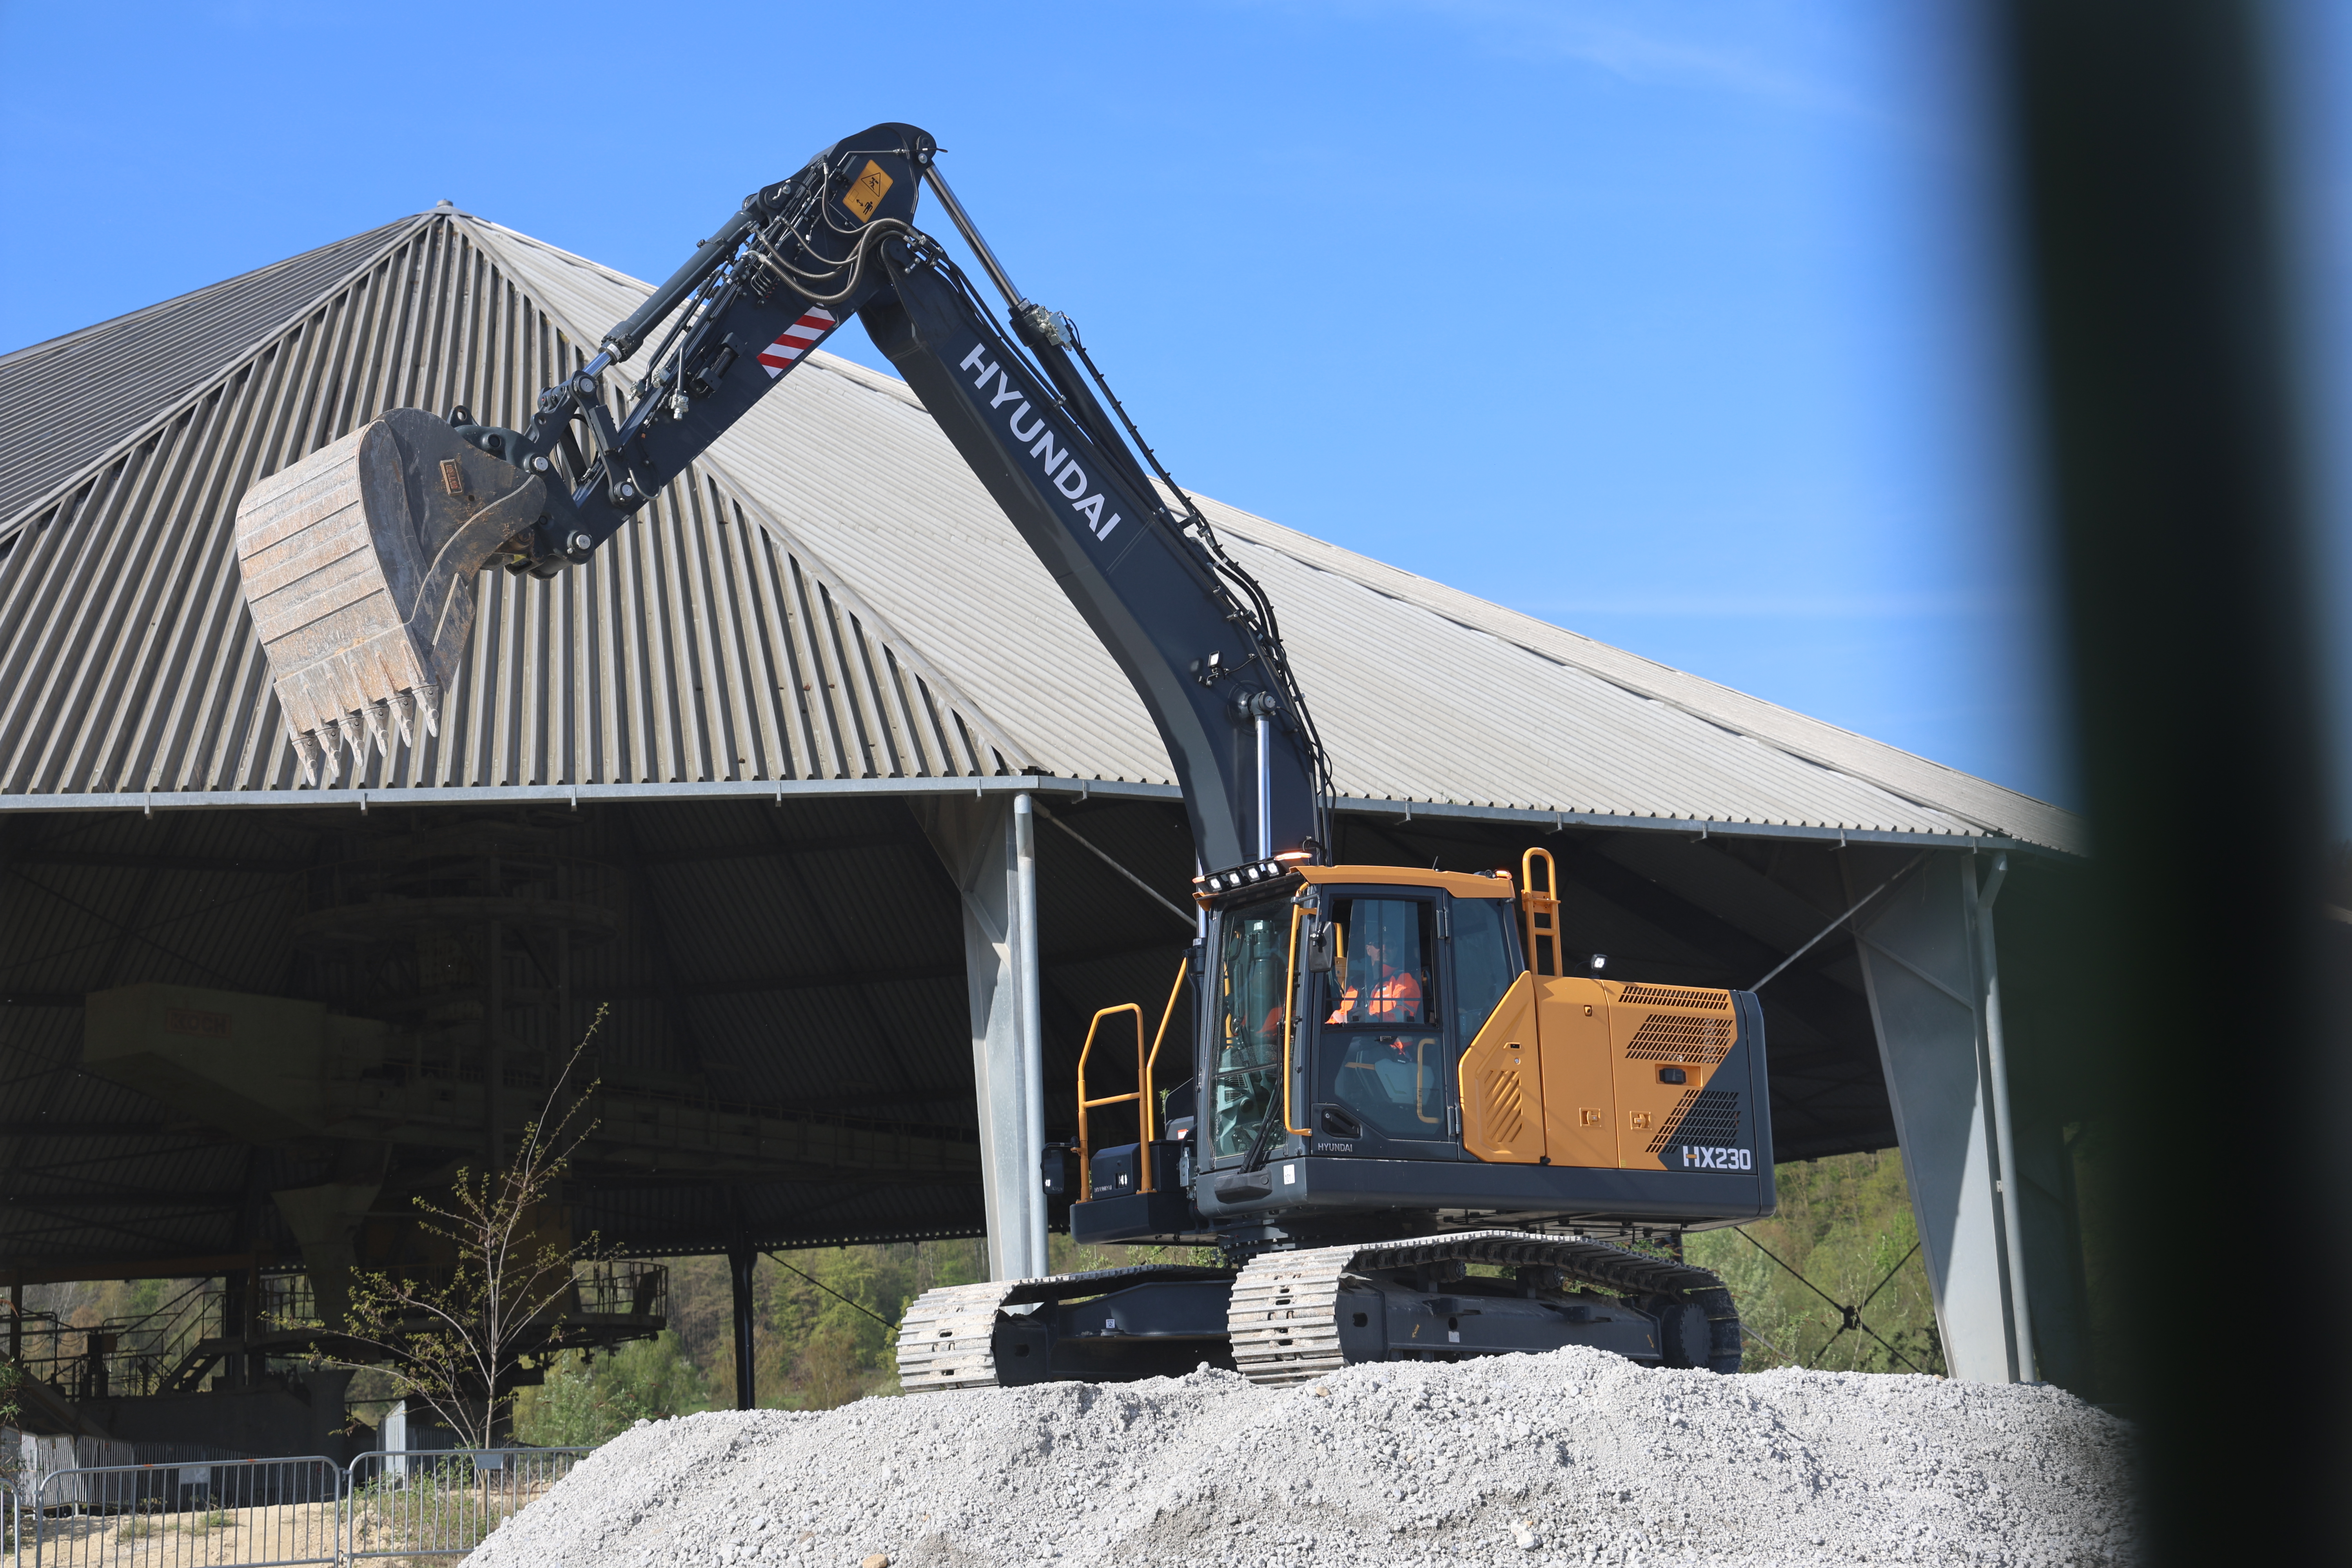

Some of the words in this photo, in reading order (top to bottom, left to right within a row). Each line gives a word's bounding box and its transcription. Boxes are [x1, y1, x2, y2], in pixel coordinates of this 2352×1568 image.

[959, 343, 1122, 542] HYUNDAI
[172, 1012, 226, 1034] KOCH
[1318, 1143, 1352, 1152] HYUNDAI
[1682, 1145, 1751, 1170] HX230
